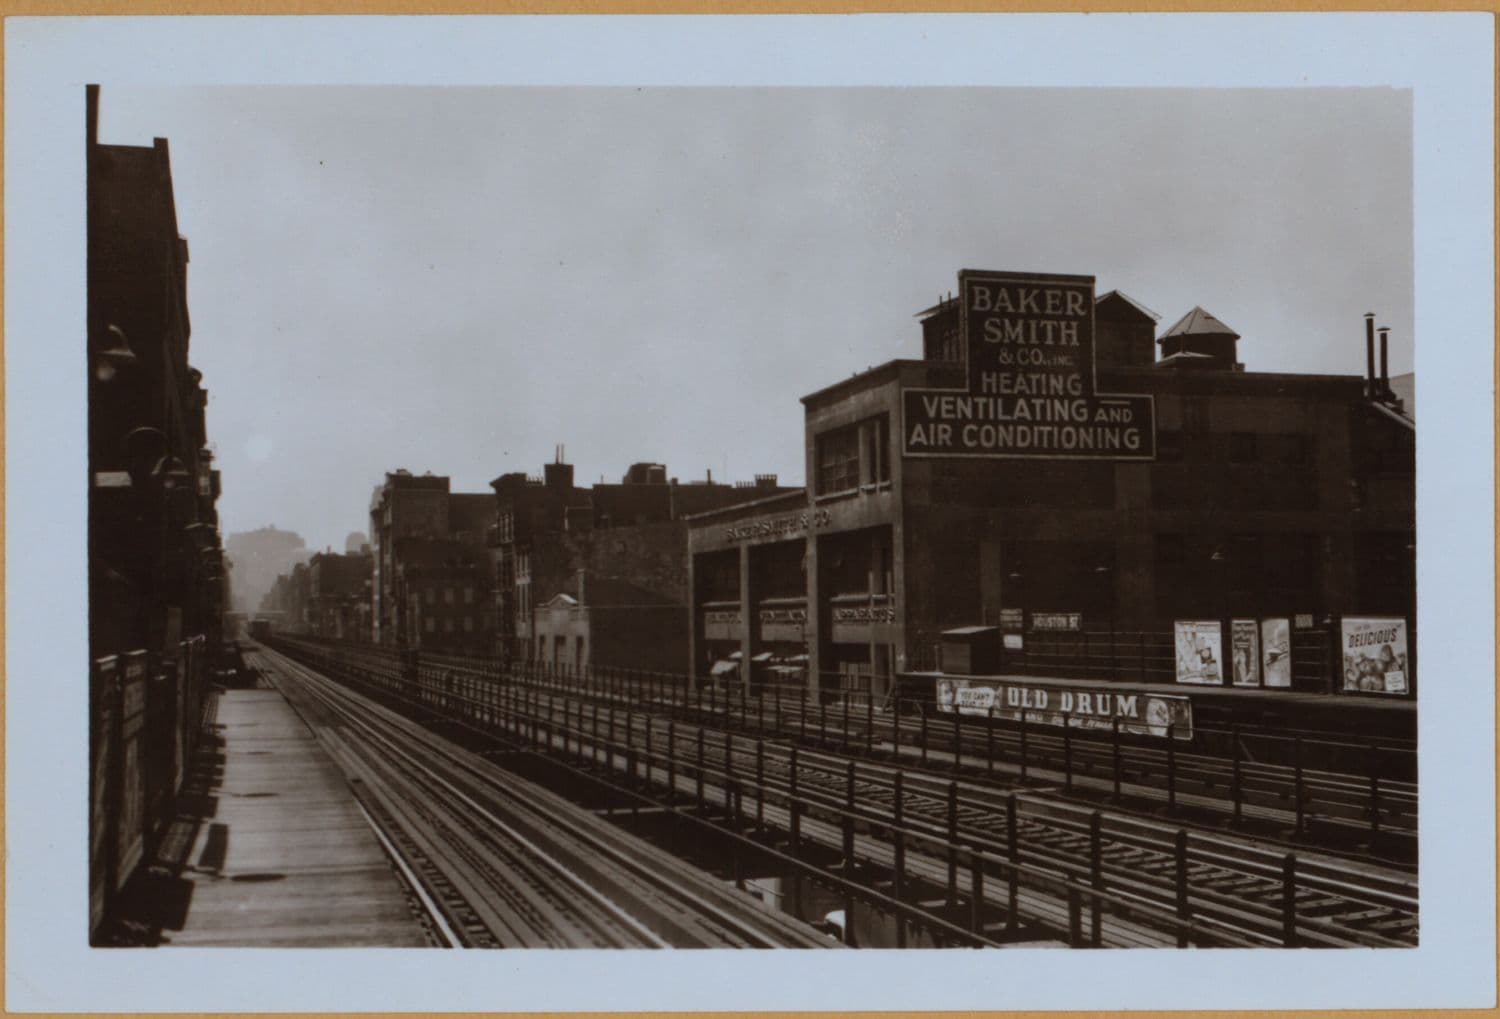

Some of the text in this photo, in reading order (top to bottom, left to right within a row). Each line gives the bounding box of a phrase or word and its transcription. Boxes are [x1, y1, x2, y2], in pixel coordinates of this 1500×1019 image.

[972, 286, 1087, 316] BAKER
[984, 318, 1080, 347] SMITH
[981, 372, 1083, 396] HEATING
[923, 396, 1133, 423] VENTILATING AND
[909, 424, 1141, 450] AIR CONDITIONING
[1348, 628, 1398, 649] DELICIOUS
[1007, 686, 1139, 718] OLD DRUM
